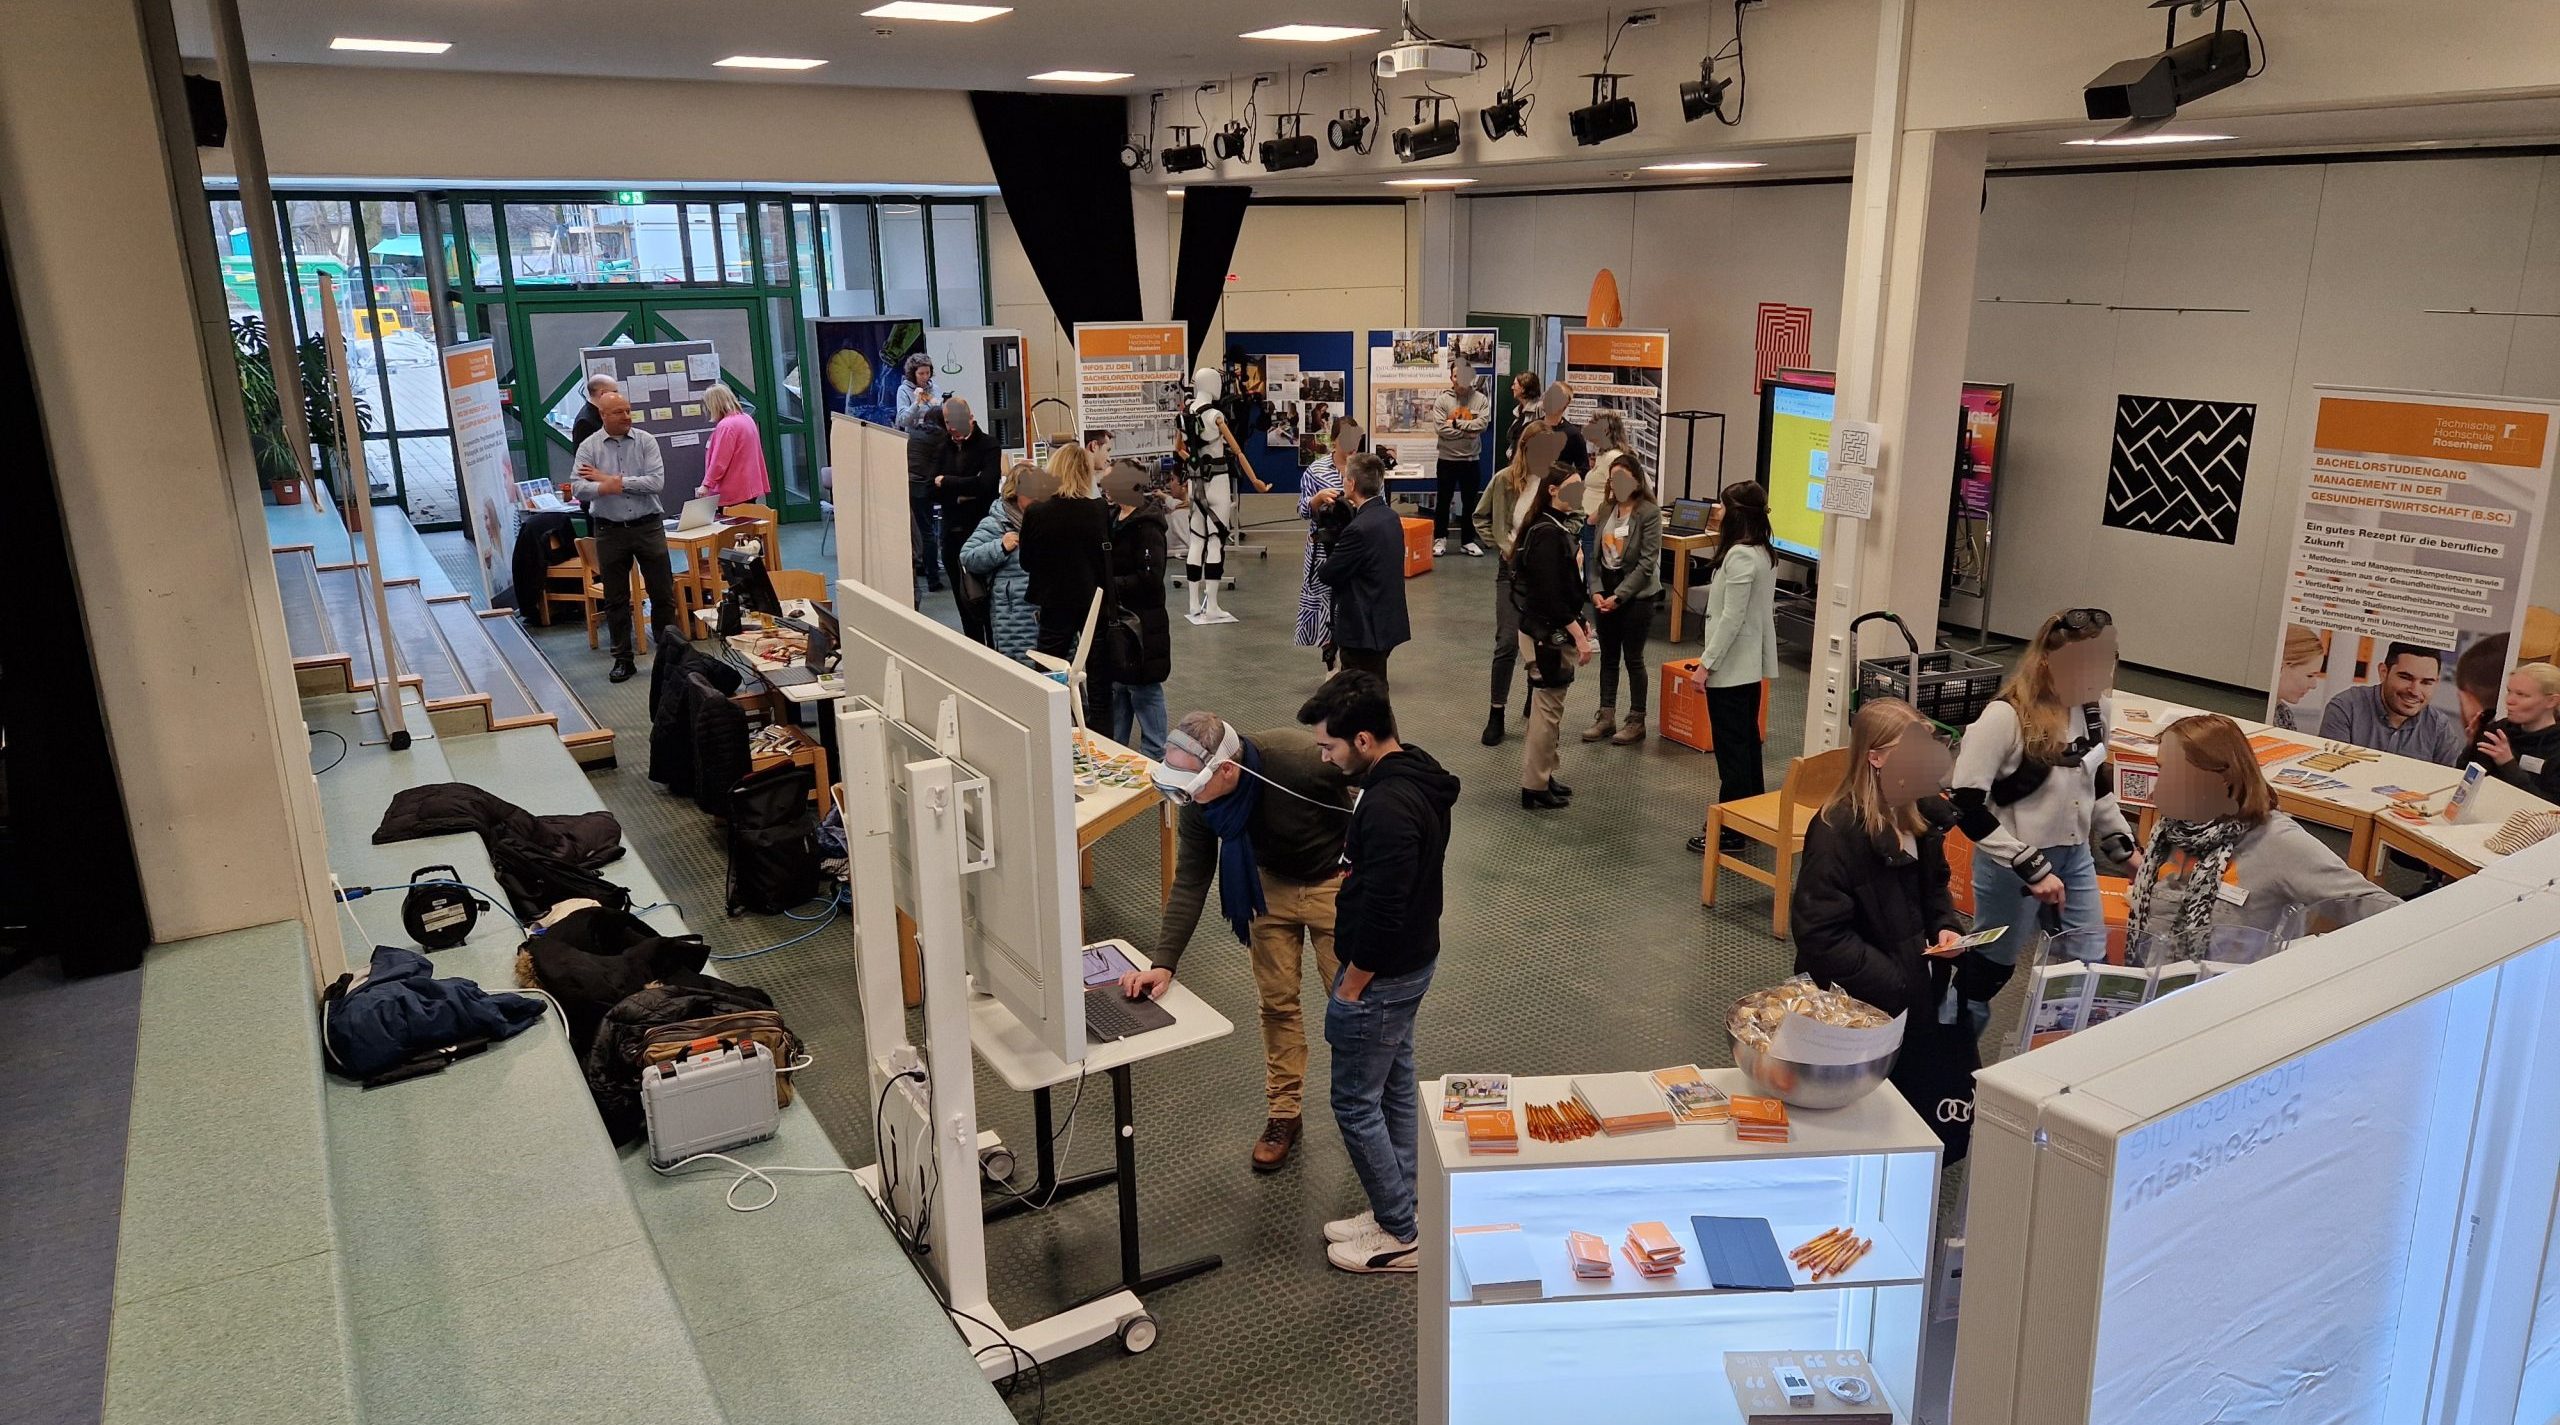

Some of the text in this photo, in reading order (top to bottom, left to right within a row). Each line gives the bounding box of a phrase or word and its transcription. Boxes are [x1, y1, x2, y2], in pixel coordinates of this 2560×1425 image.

[1092, 384, 1140, 392] BURGHAUSEN
[2434, 427, 2495, 442] Hochschule
[2436, 417, 2496, 431] Technische
[2432, 437, 2493, 451] Rosenheim
[2316, 456, 2468, 481] BACHELORSTUDIENGANG
[2313, 473, 2443, 496] MANAGEMENT IN DER
[2311, 491, 2512, 525] GESUNDHEITSWIRTSCHAFT (B.SC.)
[2303, 535, 2345, 549] Zukunft
[2306, 521, 2499, 555] Ein gutes Rezept für die berufliche
[2307, 564, 2483, 598] Praxiswissen aus der Gesundheitswirtschaft
[2308, 553, 2500, 588] Methoden- und Managementkompetenzen sowie
[2303, 591, 2450, 621] entsprechende Studienschwerpunkte
[2305, 578, 2488, 615] Vertiefung in einer Gesundheitsbranche durch
[2299, 616, 2451, 649] Einrichtungen des Gesundheitswesens
[2301, 605, 2455, 638] Enge Vernetzung mit Unternehmen und
